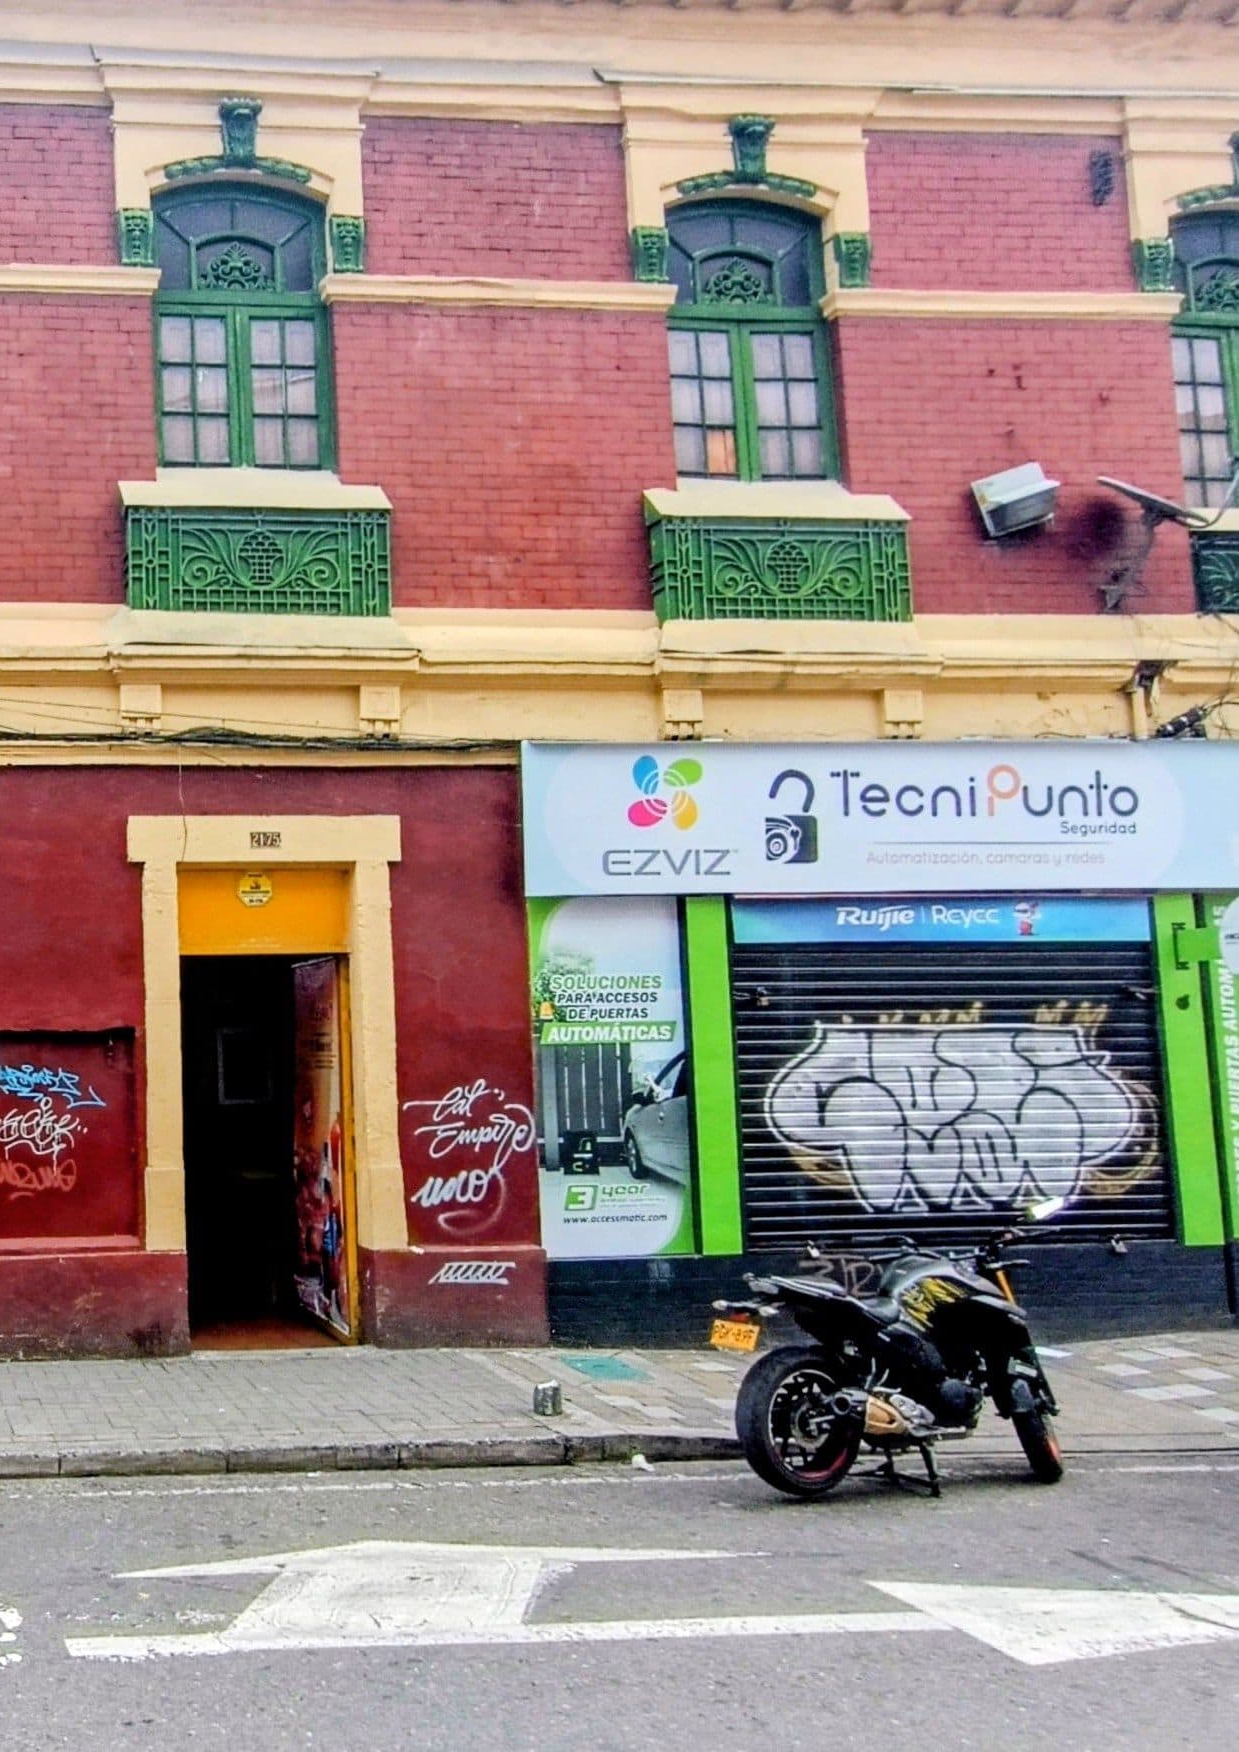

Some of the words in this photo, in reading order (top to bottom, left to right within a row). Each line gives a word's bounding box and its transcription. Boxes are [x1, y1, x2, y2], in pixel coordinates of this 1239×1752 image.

[1060, 821, 1137, 837] Seguridad
[602, 849, 731, 876] EZVIZ
[1052, 853, 1063, 867] y
[1065, 852, 1105, 864] redes
[836, 905, 914, 931] Ruijie
[552, 976, 662, 990] SOLUCIONES
[557, 993, 593, 1003] PARA
[596, 992, 658, 1003] ACCESOS
[568, 1009, 587, 1019] DE
[590, 1008, 648, 1018] PUERTAS
[548, 1022, 671, 1041] AUTOMÁTICAS
[602, 1185, 648, 1197] year
[563, 1214, 667, 1224] www.accessmatic.com
